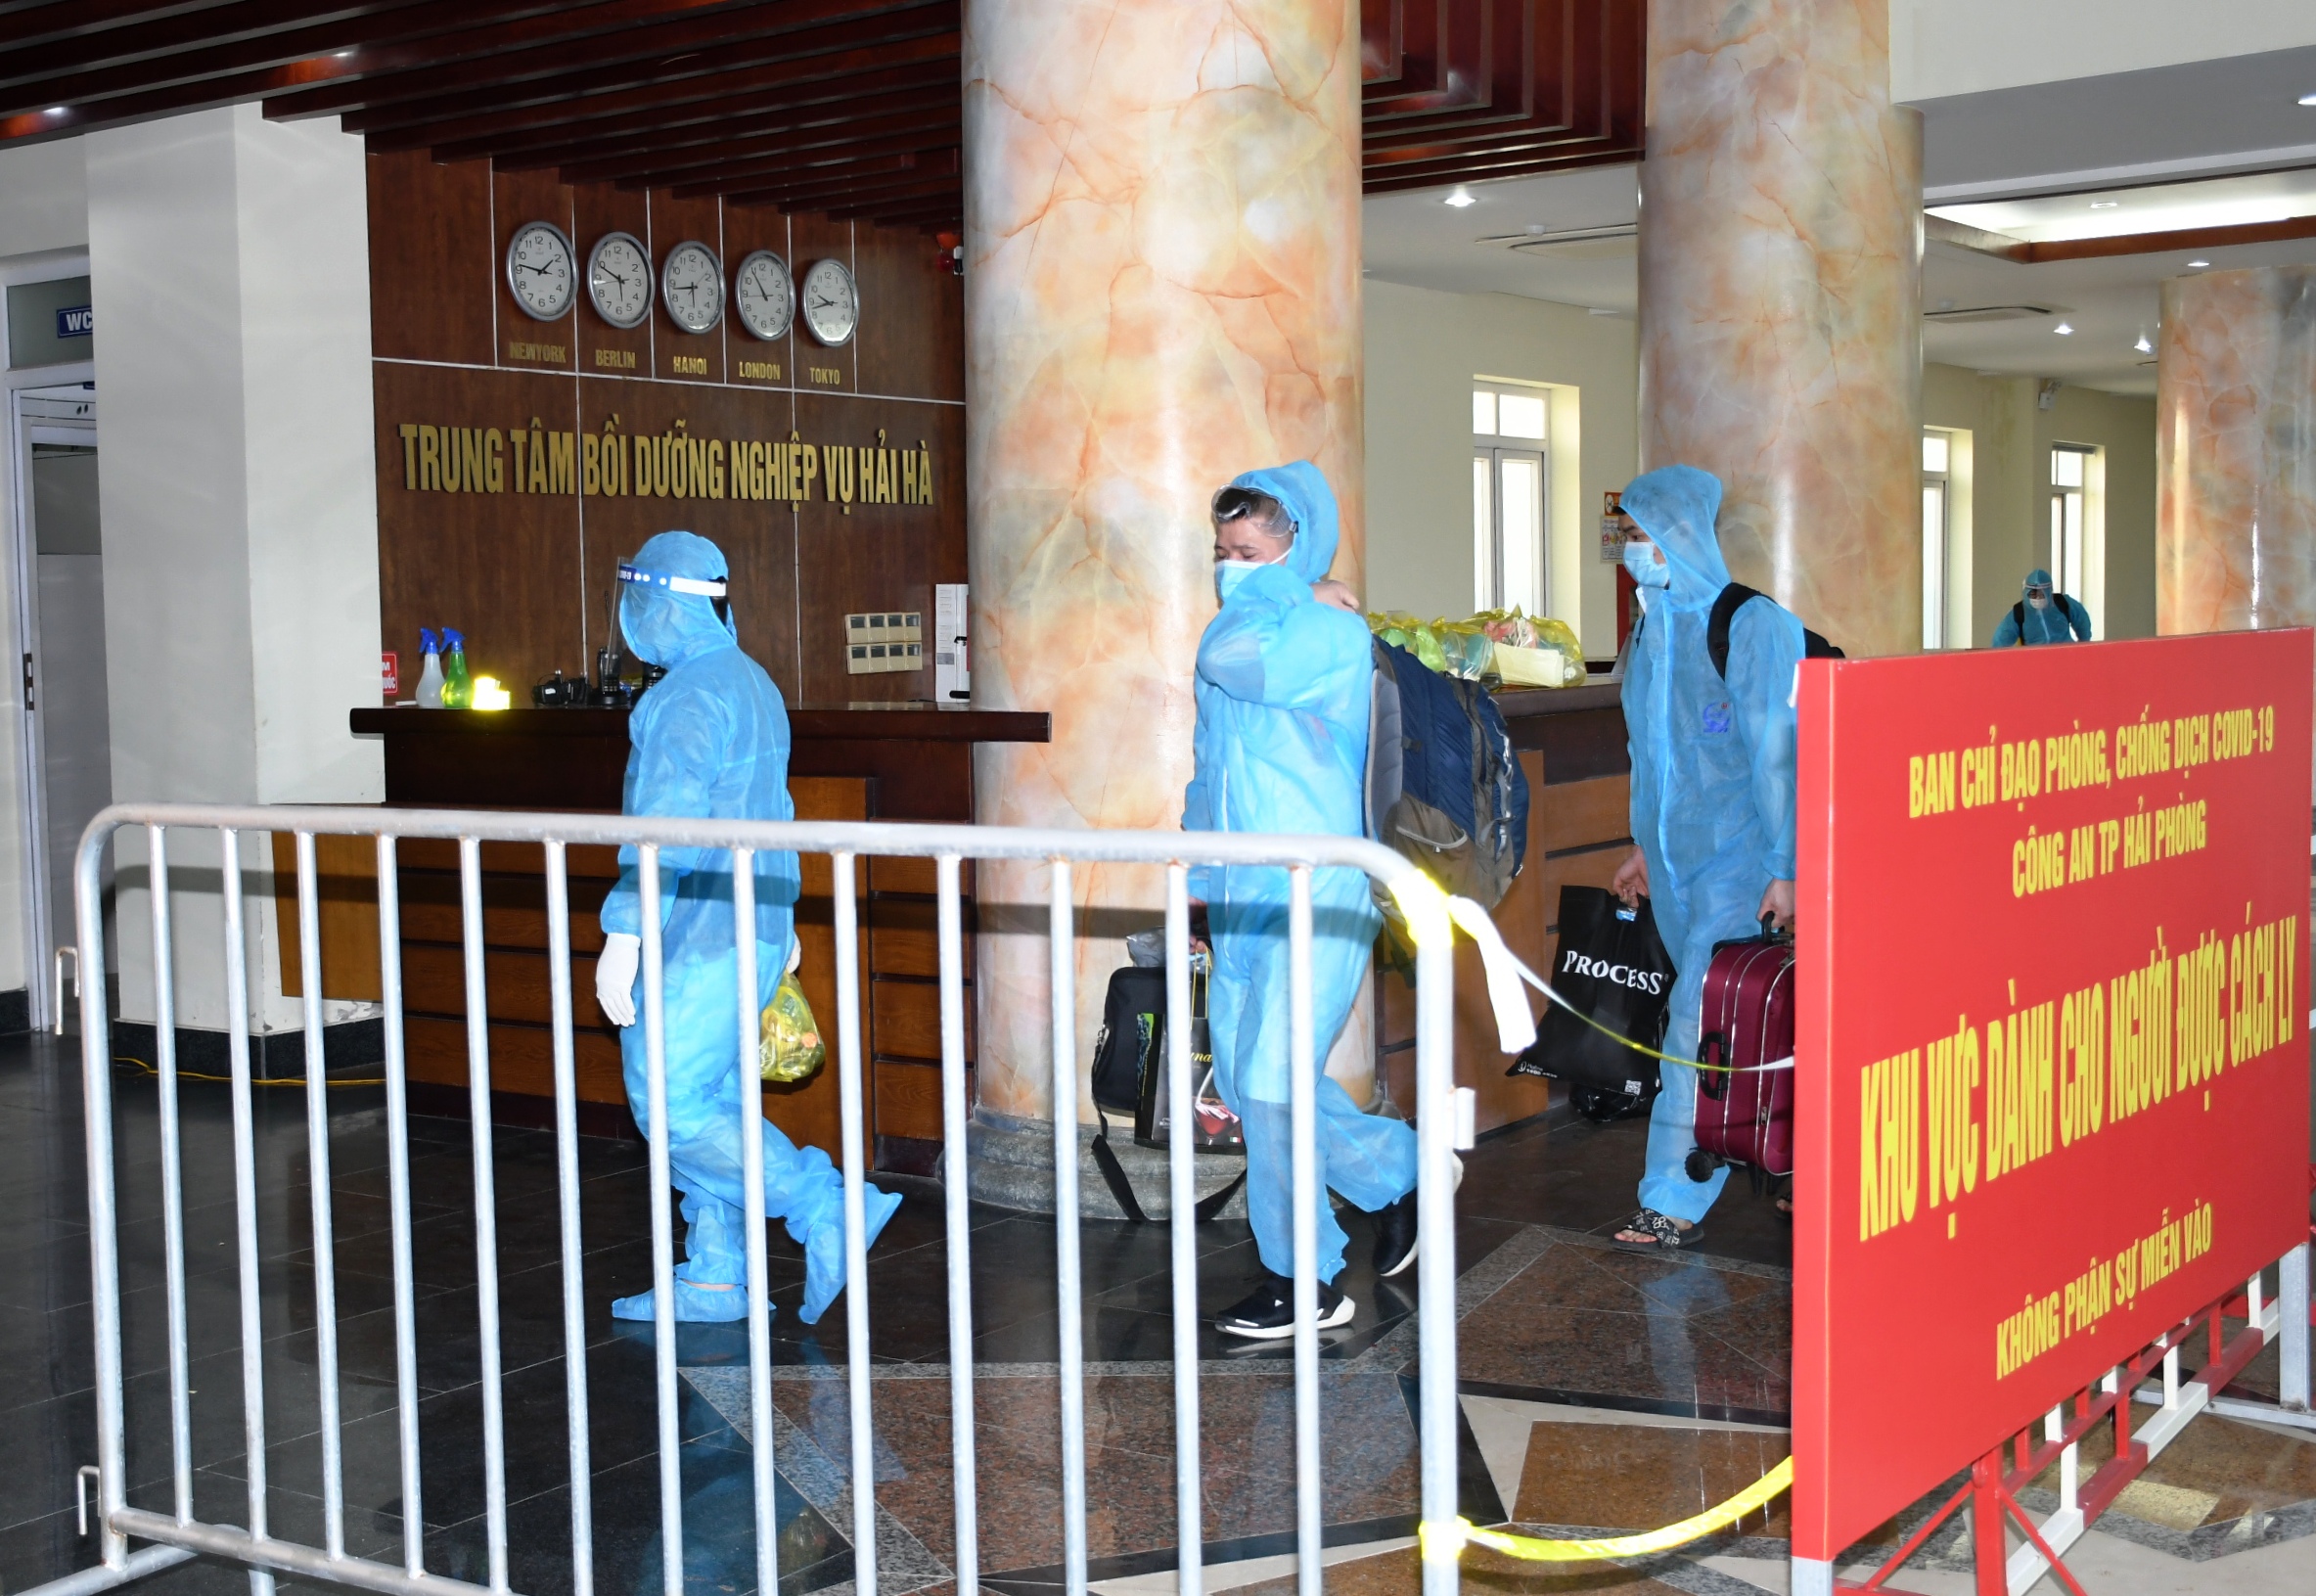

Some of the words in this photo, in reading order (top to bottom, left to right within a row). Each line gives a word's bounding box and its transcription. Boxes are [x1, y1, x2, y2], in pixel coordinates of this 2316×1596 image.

[67, 311, 93, 332] WC
[509, 342, 567, 363] NEWYORK
[595, 348, 636, 368] BERLIN
[673, 356, 707, 375] HANOI
[739, 361, 780, 380] LONDON
[809, 367, 840, 385] TOKYO
[399, 424, 504, 493] TRUNG
[510, 417, 574, 494] TÂM
[582, 413, 627, 496] BỒI
[634, 419, 723, 499] DƯỠNG
[731, 431, 817, 513] NGHIỆP
[823, 445, 853, 515] VỤ
[859, 429, 897, 504] HẢI
[902, 440, 932, 505] HÀ
[1909, 752, 1954, 818] BAN
[1961, 725, 1995, 808] CHỈ
[2001, 739, 2040, 811] ĐẠO
[2046, 719, 2111, 789] PHÒNG,
[2115, 705, 2170, 779] CHỐNG
[2174, 714, 2208, 779] DỊCH
[2213, 706, 2273, 761] COVID-19
[2013, 825, 2064, 897] CÔNG
[2068, 825, 2094, 884] AN
[2099, 820, 2119, 875] TP
[2123, 796, 2151, 869] HẢI
[2156, 792, 2205, 860] PHÒNG
[1562, 950, 1662, 994] PROCESS
[1860, 1048, 1919, 1242] KHU
[1927, 1014, 1978, 1240] VỰC
[1986, 978, 2054, 1182] DÀNH
[2060, 982, 2104, 1147] CHO
[2110, 926, 2171, 1123] NGƯỜI
[2176, 929, 2225, 1112] ĐƯỢC
[2230, 901, 2274, 1068] CÁCH
[2279, 915, 2295, 1044] LY
[1997, 1294, 2060, 1381] KHÔNG
[2065, 1256, 2111, 1339] PHẬN
[2115, 1238, 2139, 1310] SỰ
[2141, 1208, 2180, 1291] MIỄN
[2184, 1198, 2210, 1262] VÀO
